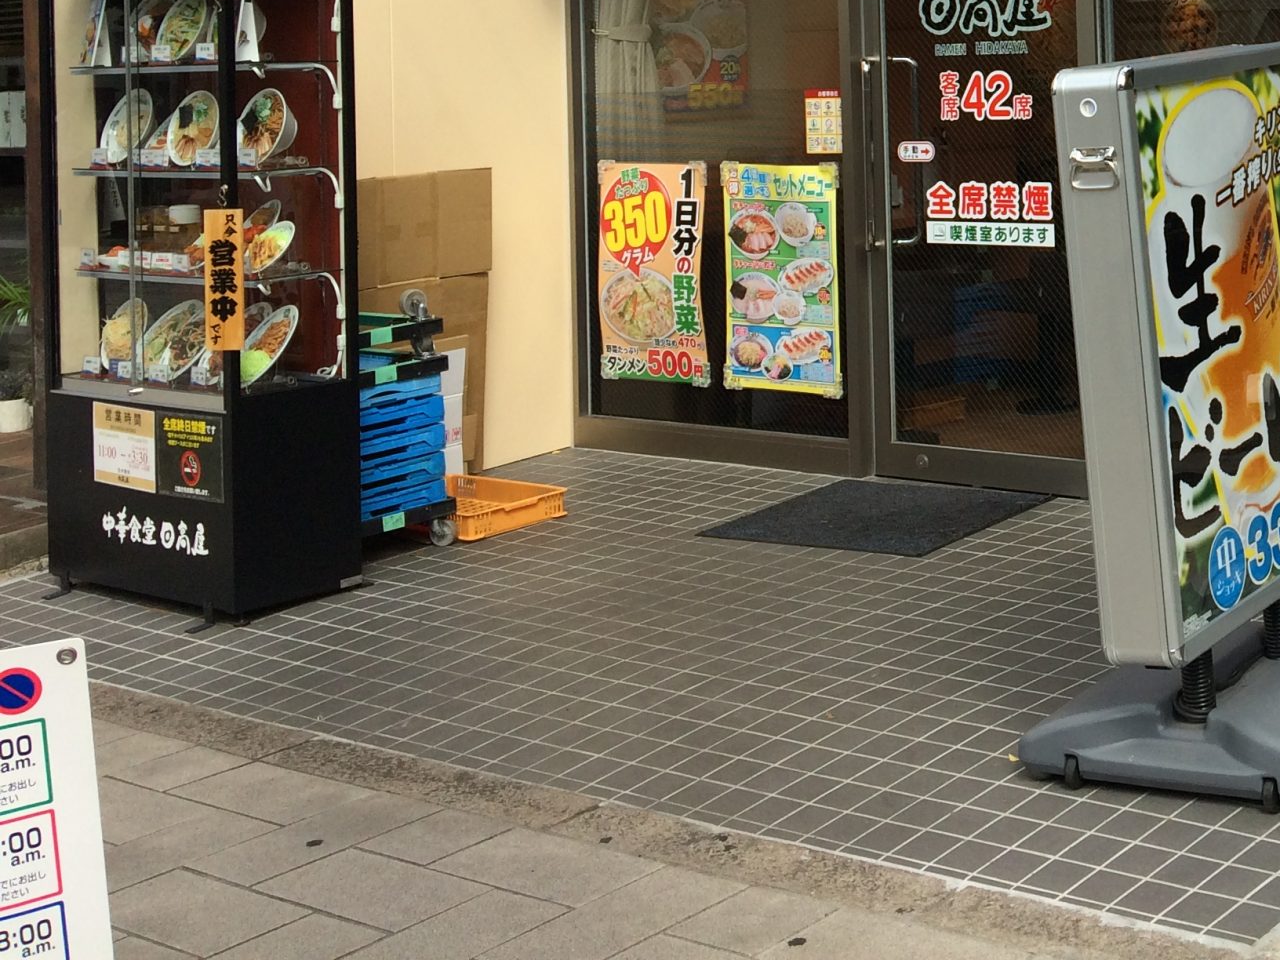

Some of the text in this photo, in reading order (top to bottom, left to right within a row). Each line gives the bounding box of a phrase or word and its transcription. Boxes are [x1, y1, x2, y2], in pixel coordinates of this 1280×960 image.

[934, 40, 1028, 57] RAMEN HIDAKAYA
[940, 71, 959, 121] 客席
[773, 173, 833, 198] セットメニュー
[927, 181, 1053, 220] 全席禁煙
[223, 213, 237, 238] 只今
[603, 191, 668, 253] 350
[950, 225, 1049, 243] 喫煙室あります
[621, 246, 655, 268] グラム
[672, 168, 702, 336] 1日分の野菜
[208, 239, 238, 323] 営業中
[1159, 193, 1242, 393] 生
[607, 356, 647, 375] タンメン
[102, 505, 209, 557] 中華食堂 日高屋
[1216, 537, 1236, 578] 中
[1, 757, 36, 773] a.m.
[10, 848, 46, 867] a.m.
[22, 939, 56, 958] a.m.
